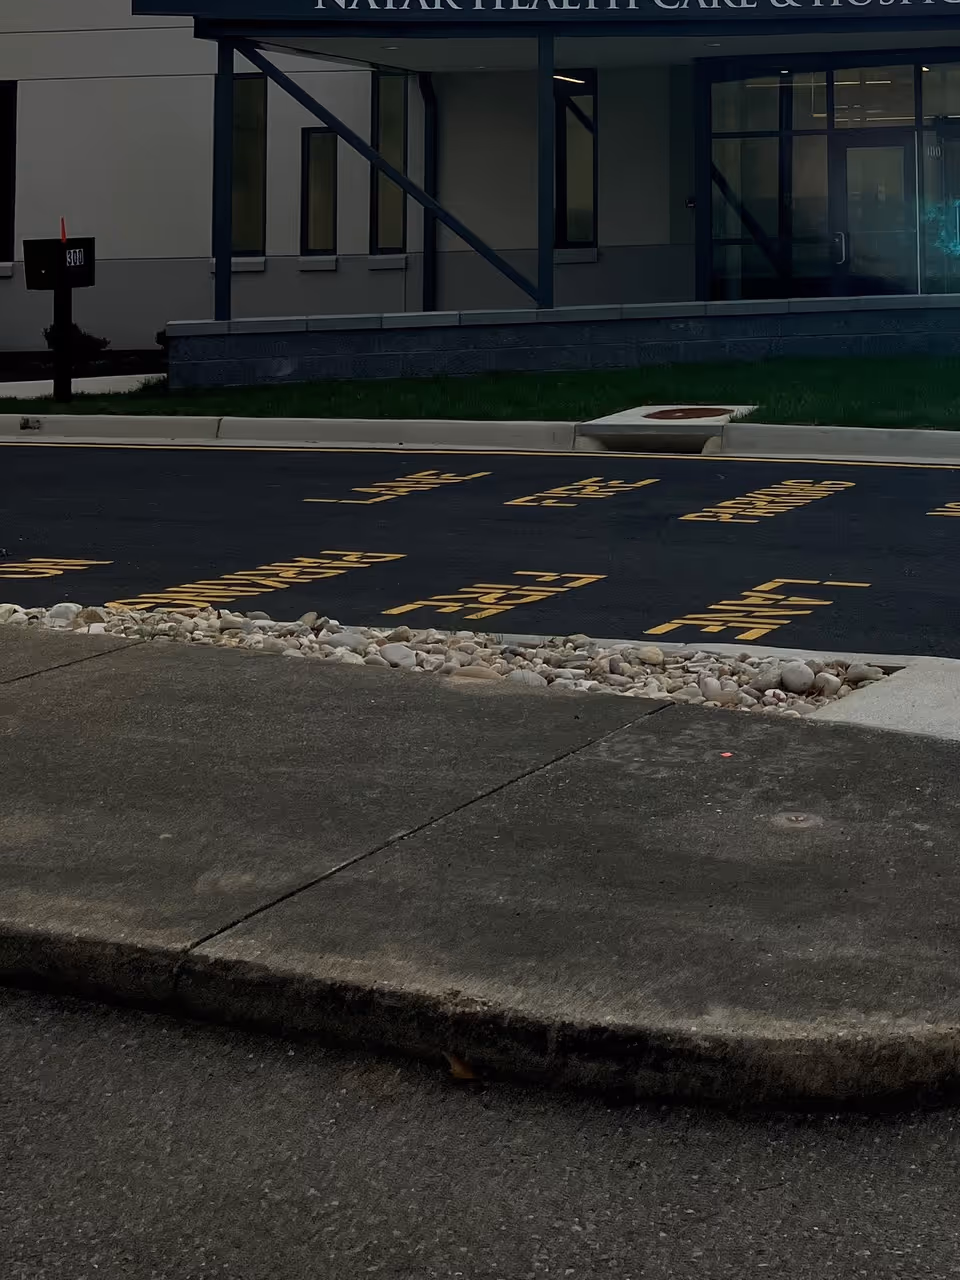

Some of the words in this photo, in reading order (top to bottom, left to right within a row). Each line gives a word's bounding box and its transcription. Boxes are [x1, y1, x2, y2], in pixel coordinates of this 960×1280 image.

[67, 249, 84, 266] 300
[303, 470, 493, 504] LANE
[503, 476, 661, 507] FIRE
[677, 479, 856, 523] PARKING
[380, 570, 608, 619] FIRE
[642, 578, 872, 640] LANE
